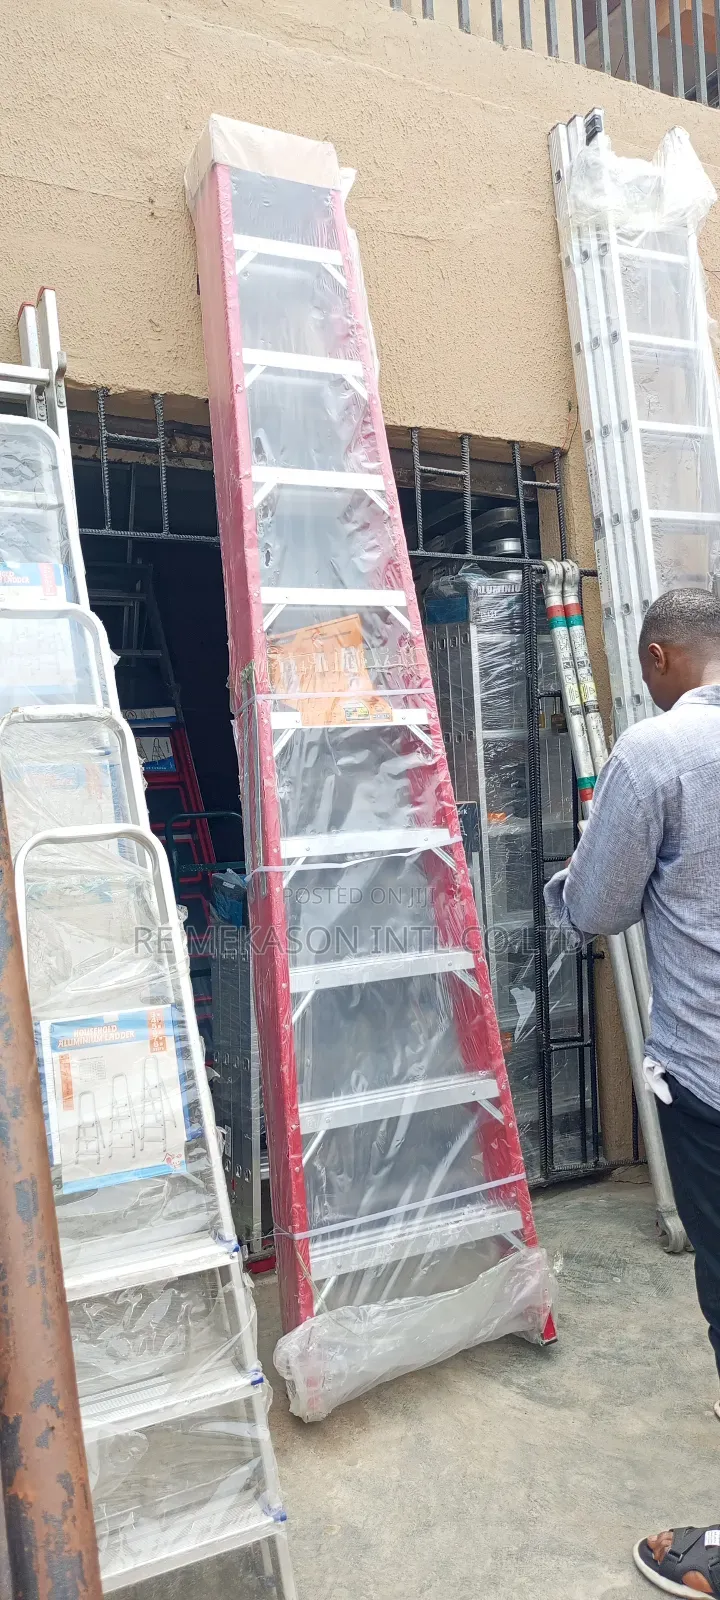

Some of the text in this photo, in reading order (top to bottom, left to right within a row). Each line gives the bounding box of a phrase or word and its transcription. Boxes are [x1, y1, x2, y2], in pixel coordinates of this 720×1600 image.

[477, 584, 522, 595] ALUMINIU
[73, 1024, 118, 1038] HOUSEHOLD
[58, 1030, 136, 1048] ALUMINIUM LADDER
